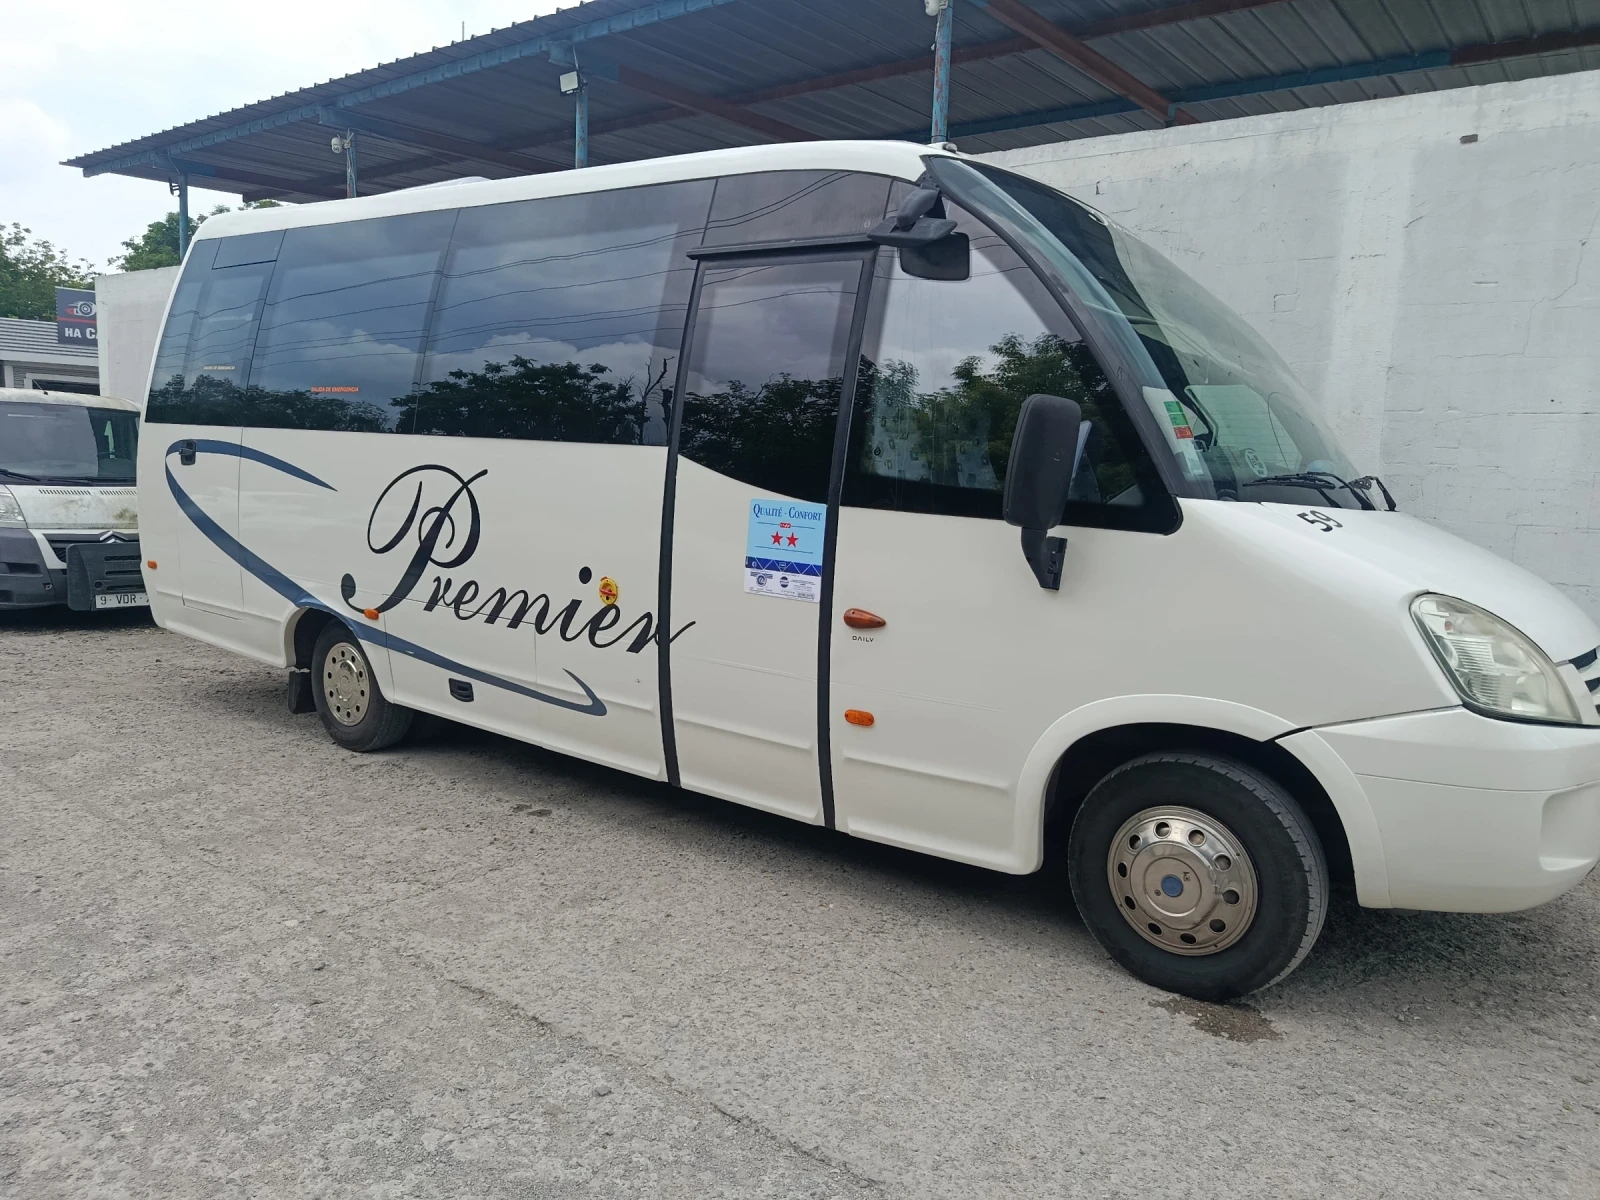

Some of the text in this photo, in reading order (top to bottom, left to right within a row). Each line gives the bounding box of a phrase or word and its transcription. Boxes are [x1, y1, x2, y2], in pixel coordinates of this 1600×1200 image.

[64, 328, 98, 340] HA C
[788, 506, 822, 521] CONFORT
[1297, 510, 1343, 532] 59
[341, 464, 696, 654] Premier
